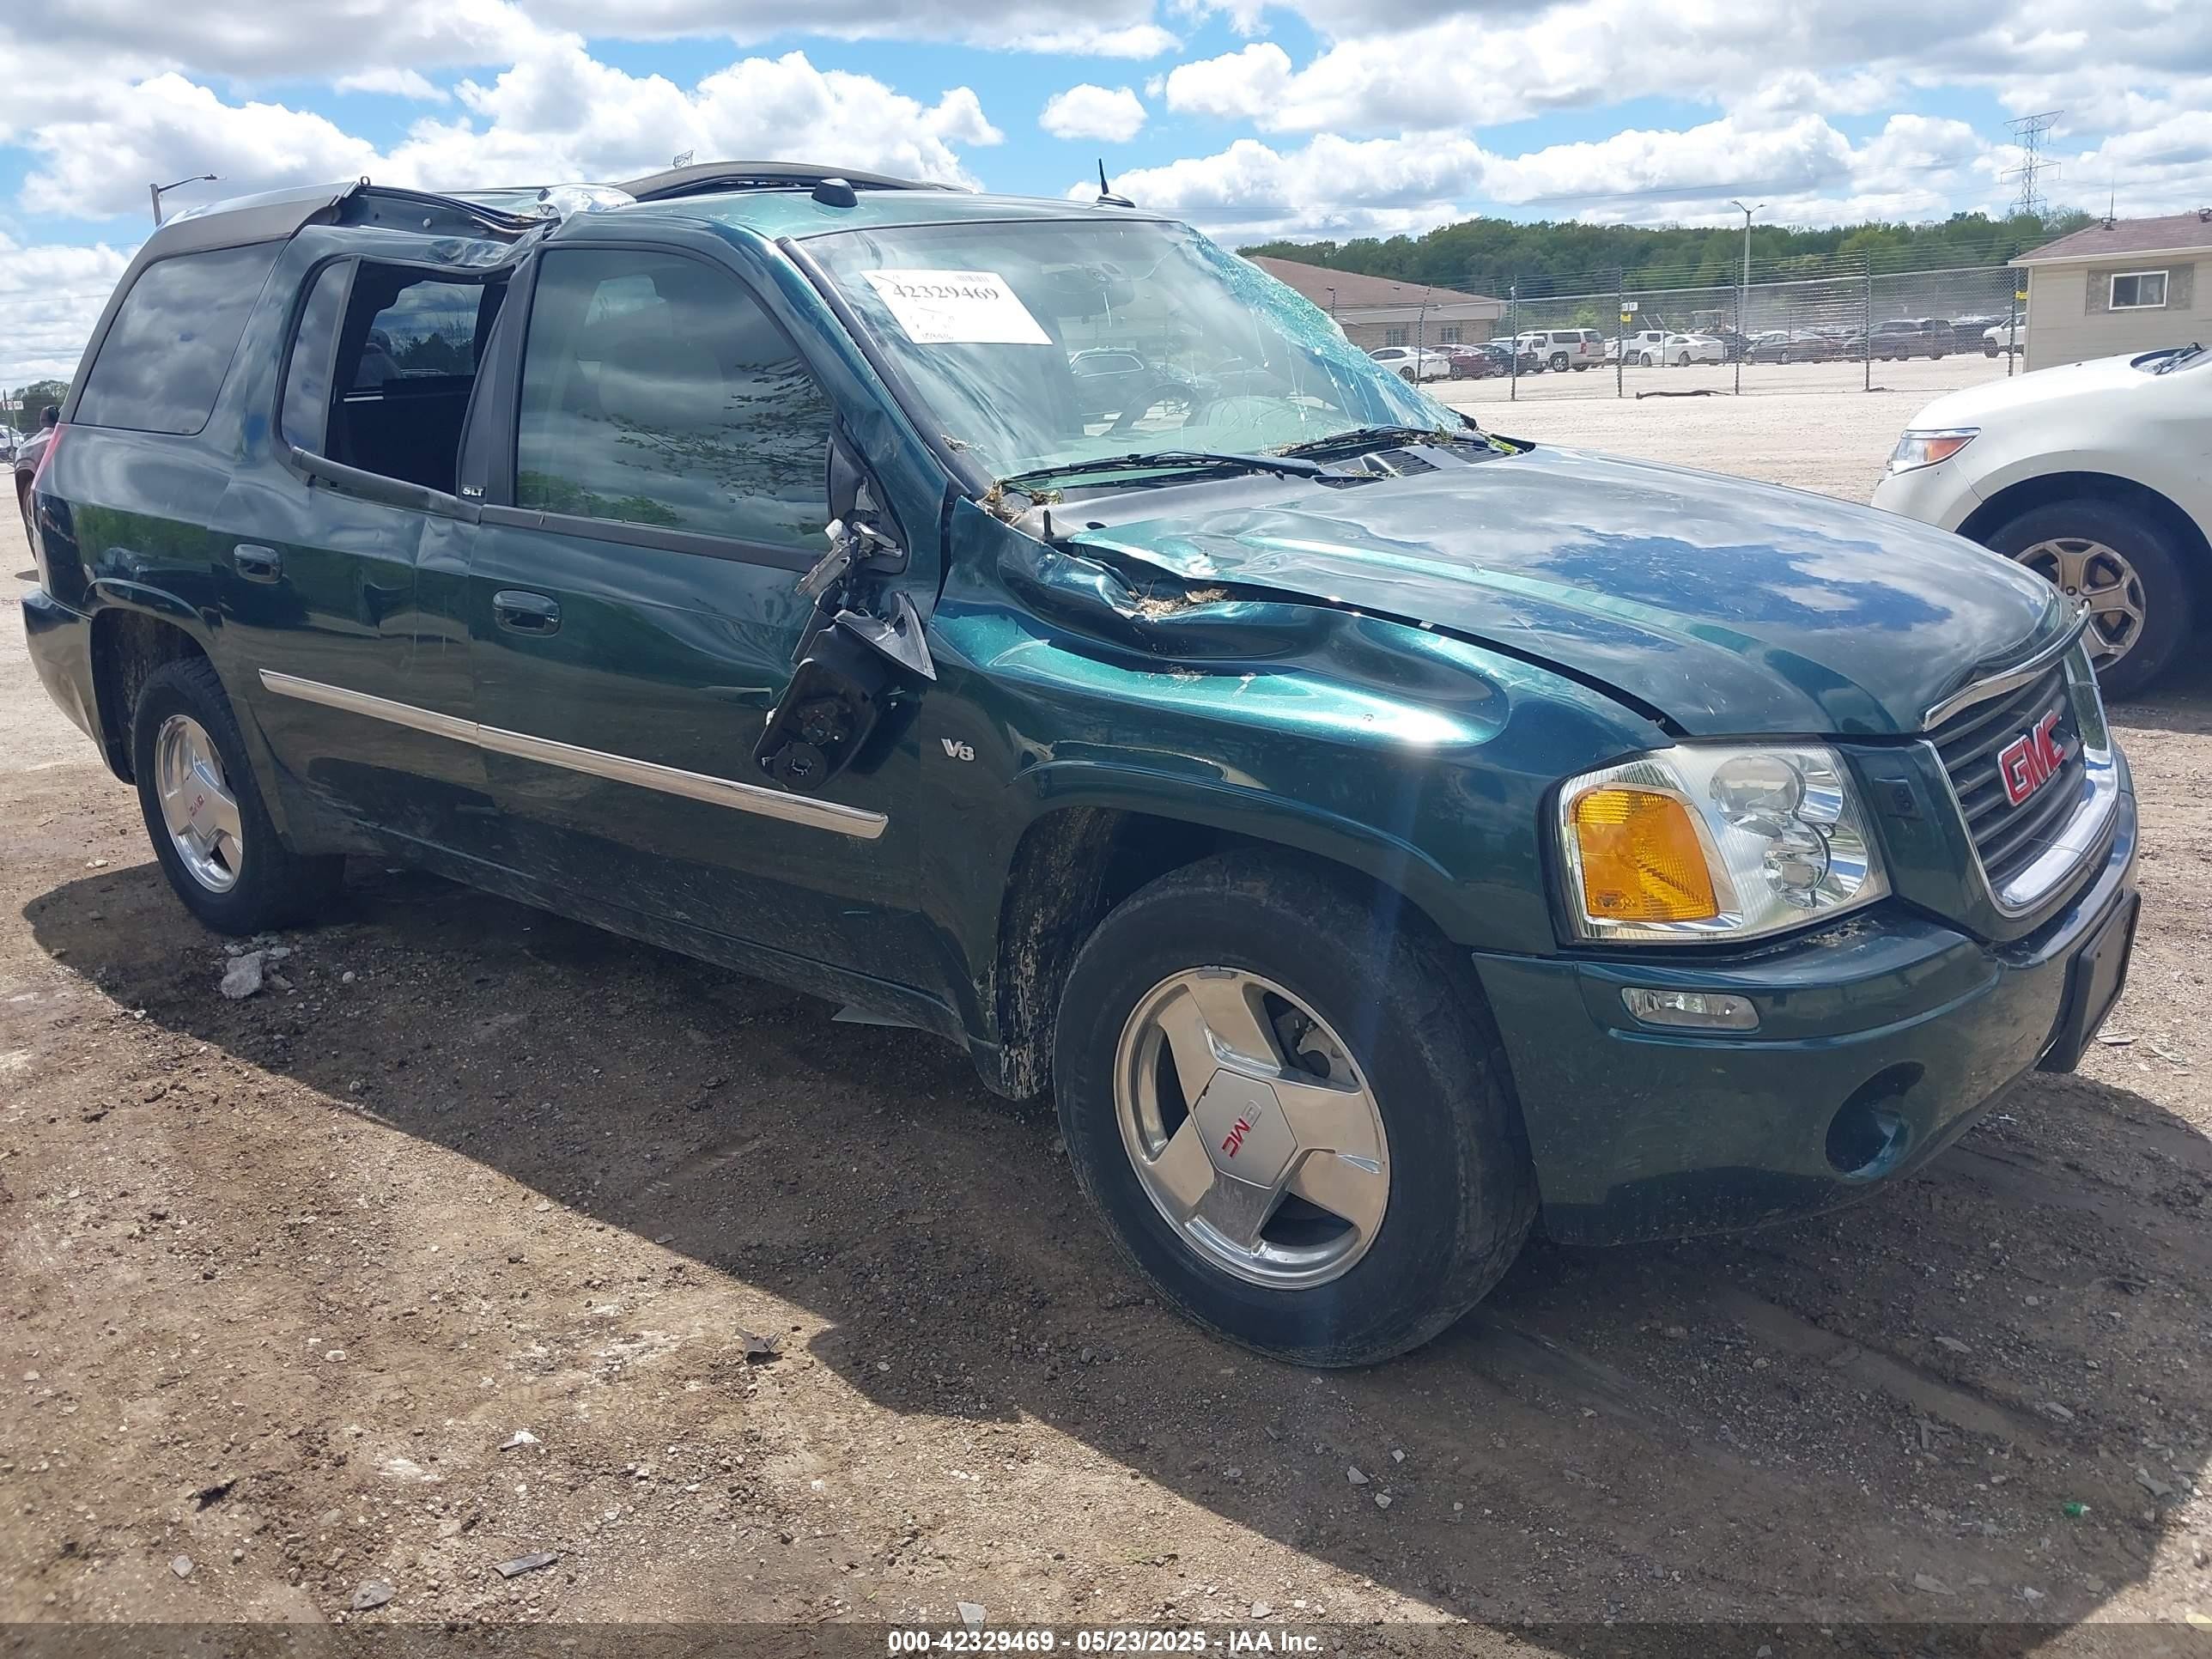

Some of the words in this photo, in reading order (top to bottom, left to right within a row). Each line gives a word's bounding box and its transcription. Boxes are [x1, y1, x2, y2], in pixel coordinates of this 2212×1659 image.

[893, 284, 999, 300] 42329469
[463, 487, 483, 496] SLT
[940, 738, 975, 762] V8
[1997, 709, 2065, 806] GMC
[1220, 1099, 1262, 1159] GMC
